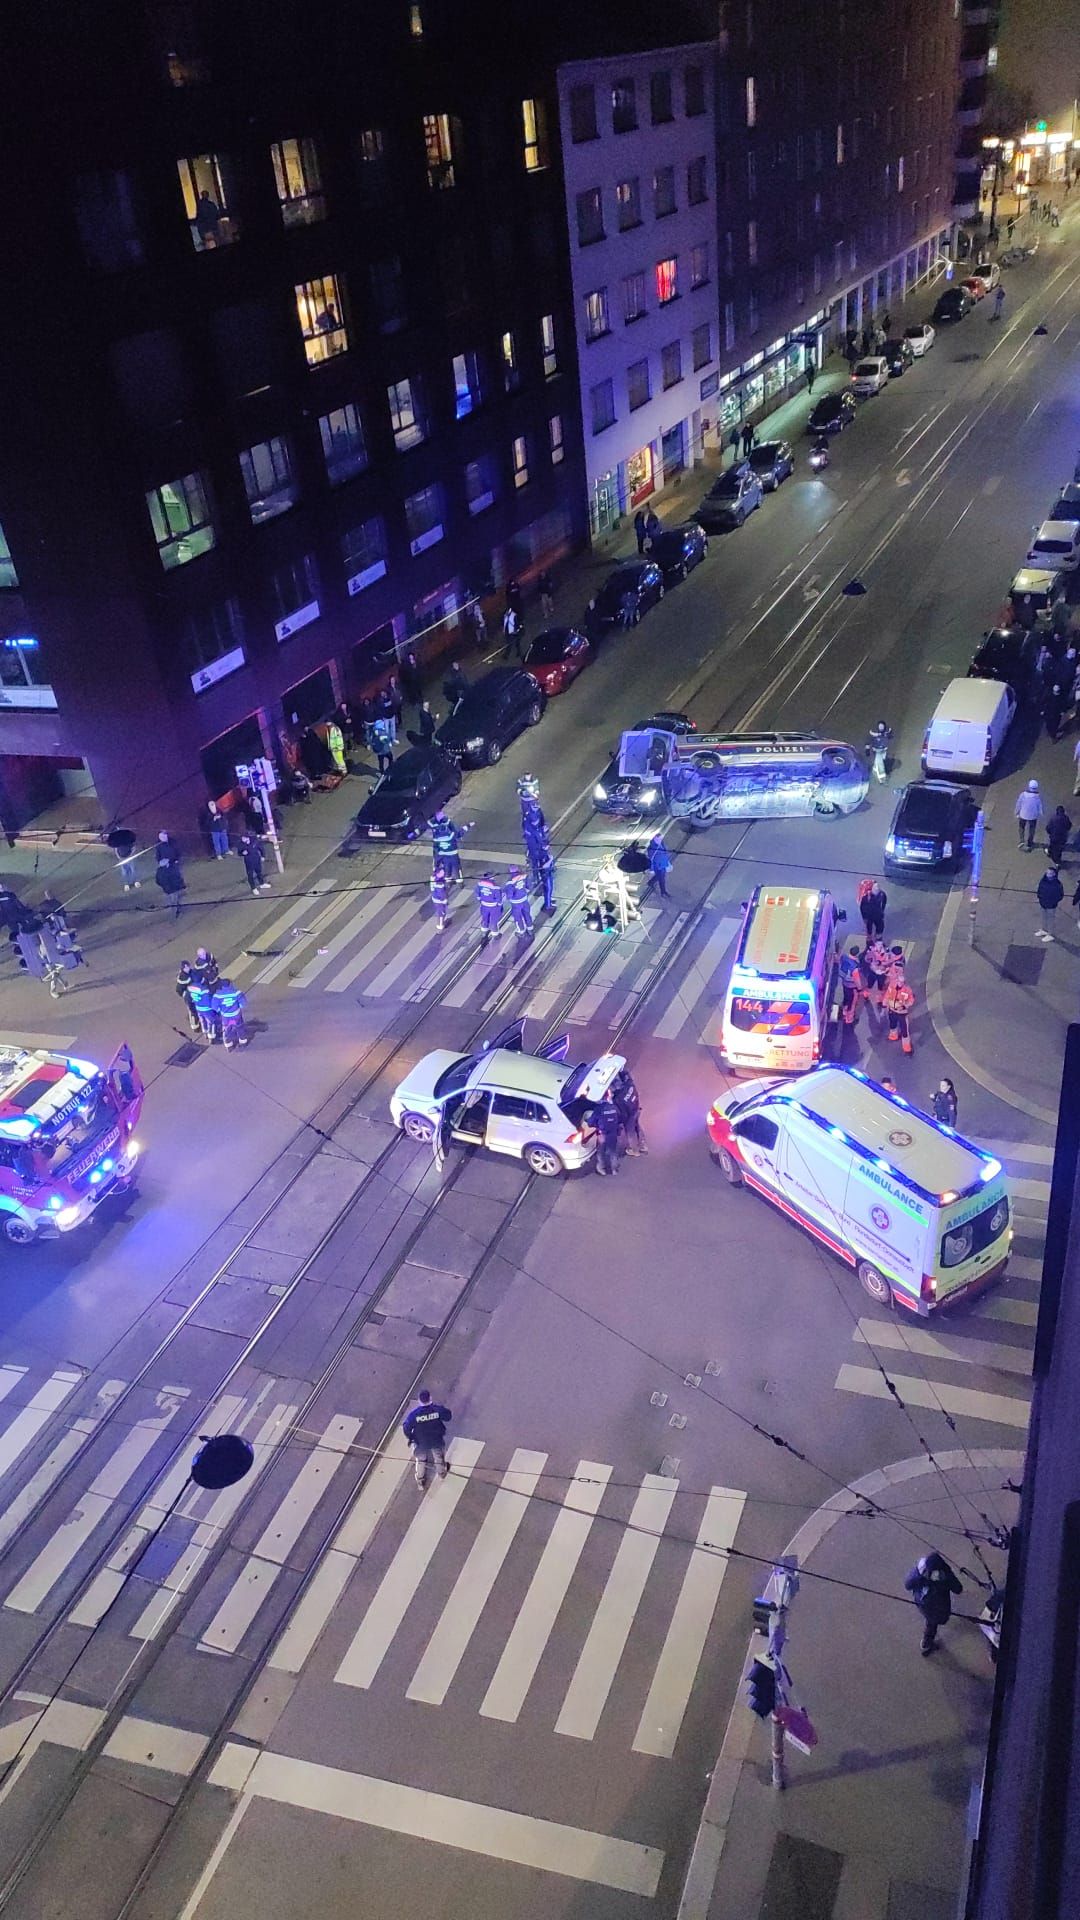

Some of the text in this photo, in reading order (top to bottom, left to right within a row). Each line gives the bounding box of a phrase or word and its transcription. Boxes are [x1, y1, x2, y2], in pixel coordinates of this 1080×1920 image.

[755, 746, 804, 754] POLIZEI
[735, 998, 764, 1013] 144
[769, 1048, 810, 1058] RETTUNG
[51, 1085, 94, 1127] NOTRUF 122
[66, 1126, 121, 1184] FEUERWEHR
[858, 1163, 925, 1215] AMBULANCE
[415, 1412, 440, 1423] POLIZEI
